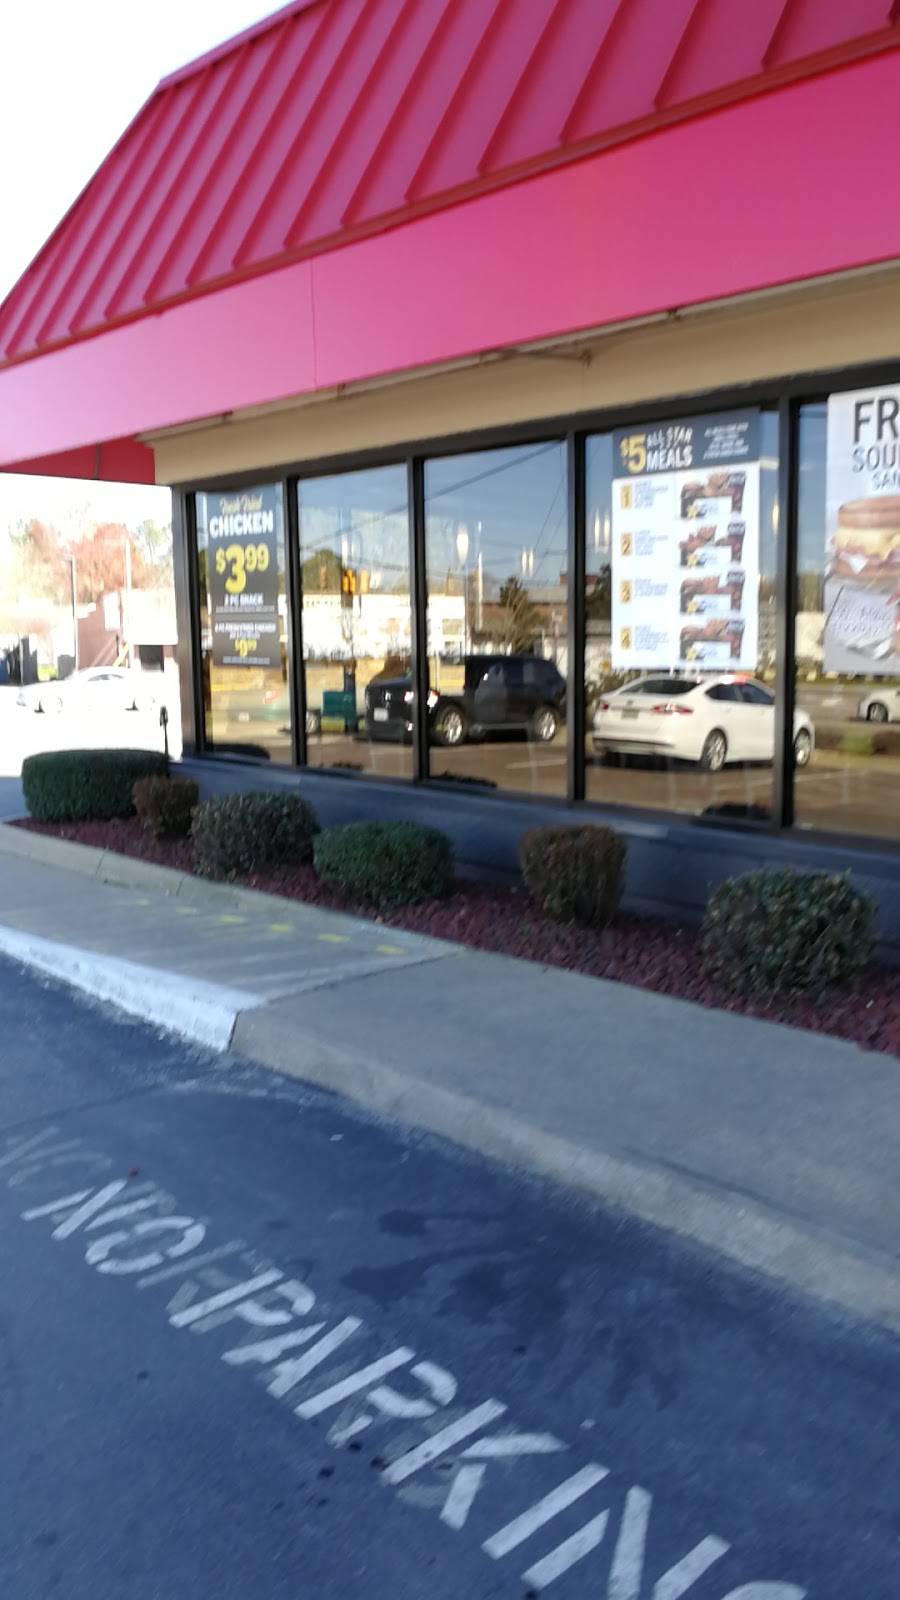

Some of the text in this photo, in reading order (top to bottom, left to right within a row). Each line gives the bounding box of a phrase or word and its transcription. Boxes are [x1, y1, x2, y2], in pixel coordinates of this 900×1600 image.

[666, 426, 693, 449] STAR
[620, 434, 646, 474] $5
[646, 445, 692, 471] MEALS
[852, 444, 900, 473] SOU
[209, 509, 273, 539] CHICKEN
[20, 1178, 809, 1600] NO PARKIN
